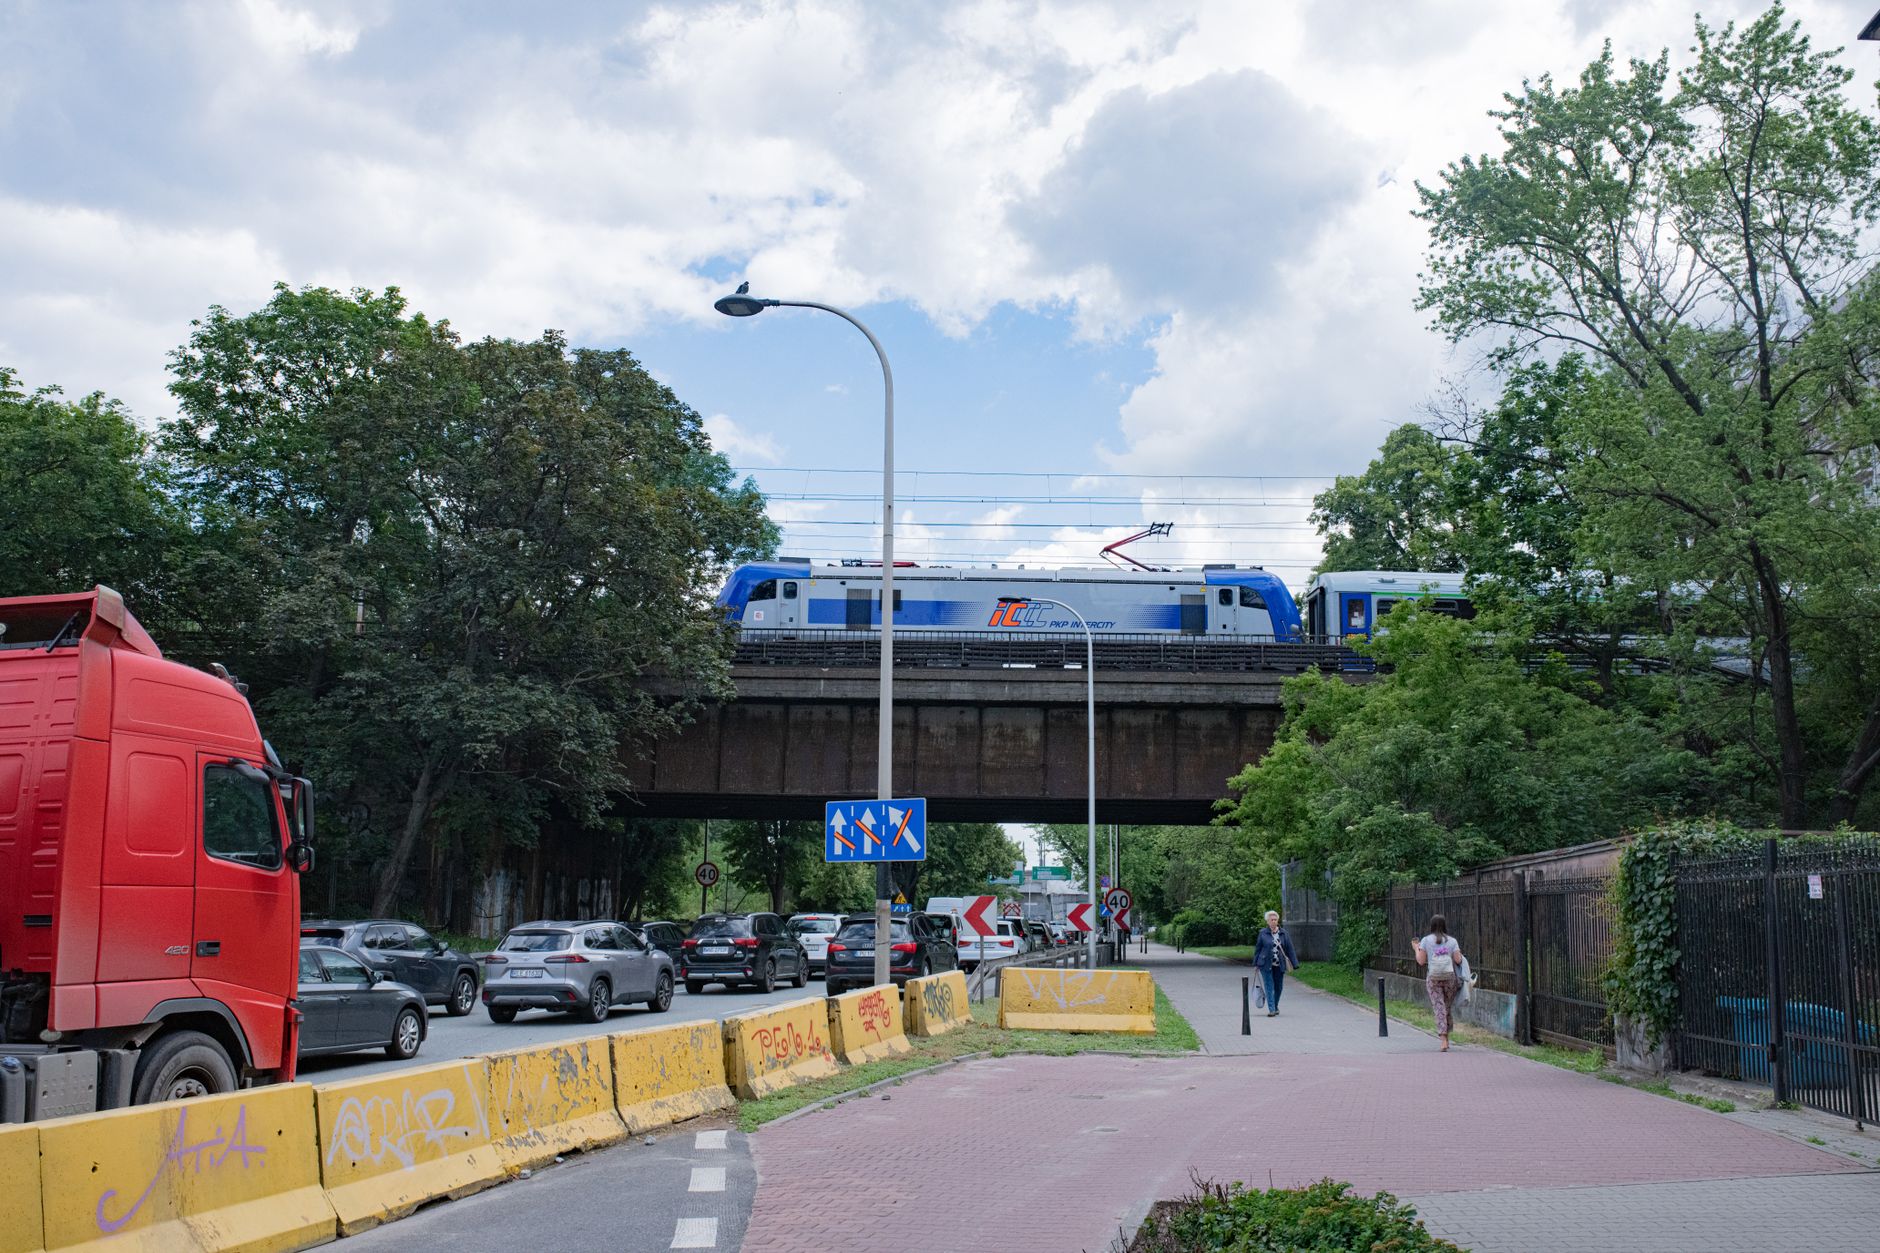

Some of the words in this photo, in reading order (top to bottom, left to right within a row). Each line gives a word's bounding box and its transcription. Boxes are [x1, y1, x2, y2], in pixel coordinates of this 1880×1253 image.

[699, 868, 715, 880] 40
[1109, 895, 1129, 908] 40
[164, 945, 190, 955] 420
